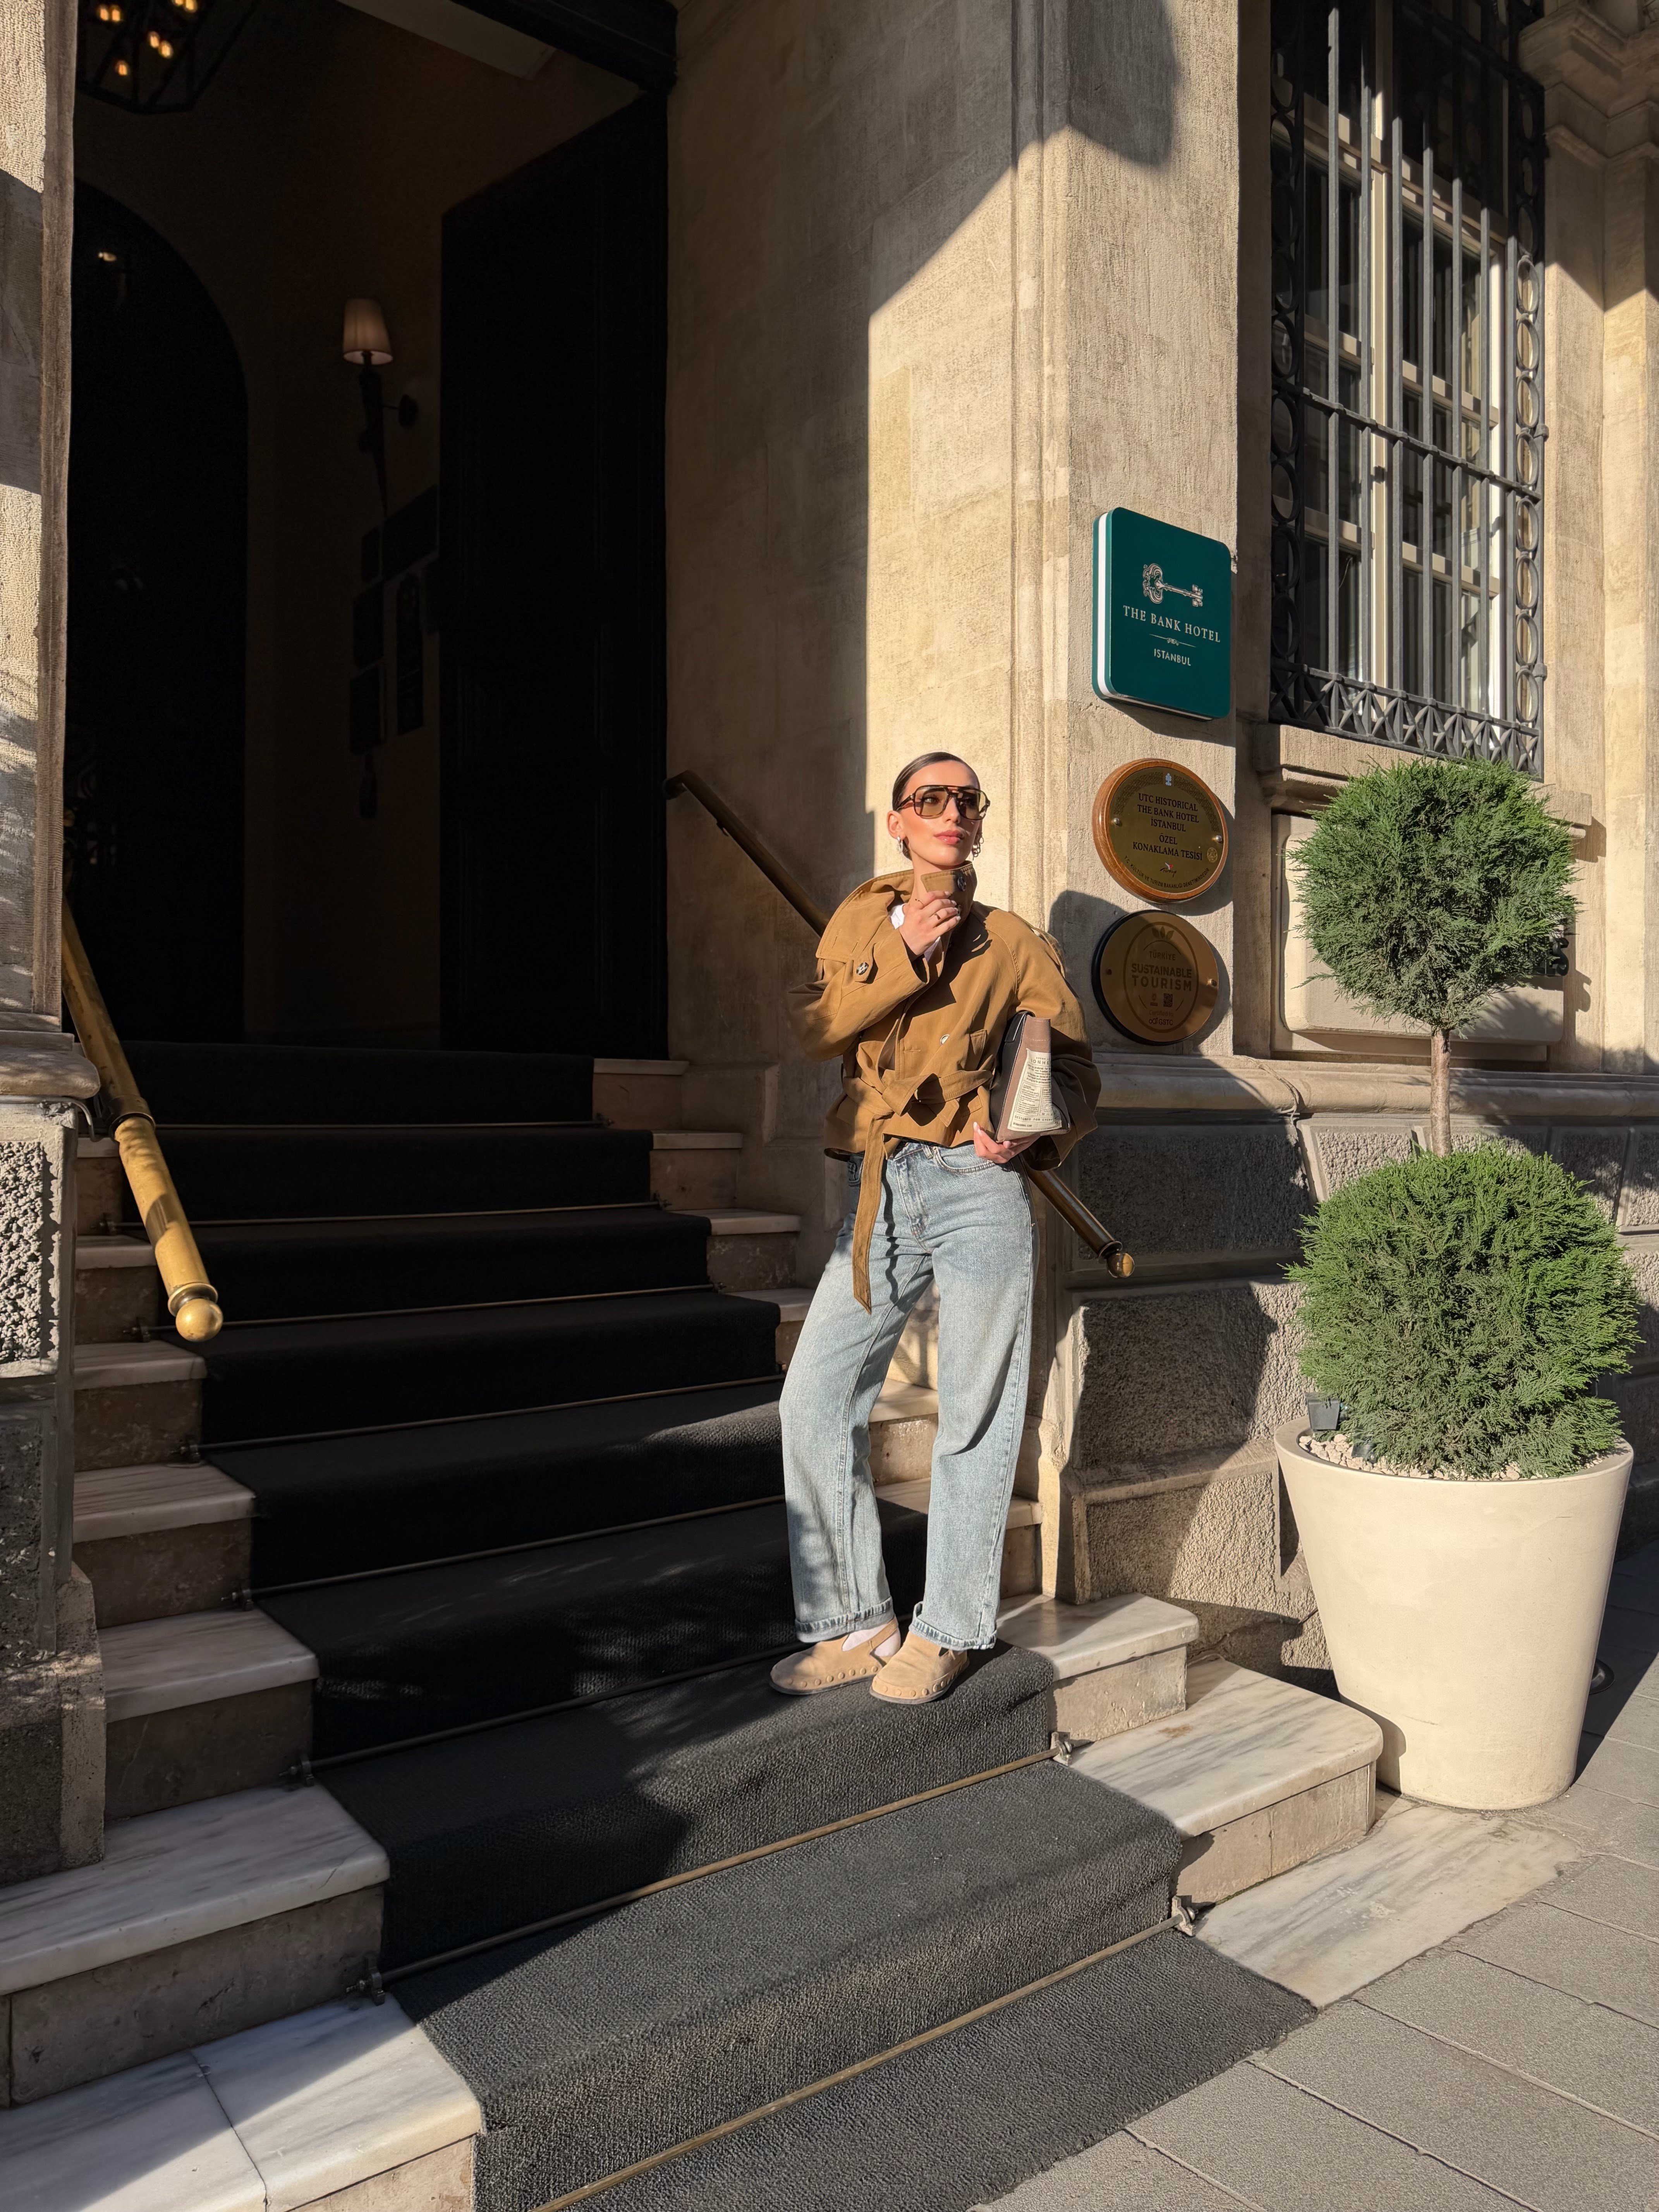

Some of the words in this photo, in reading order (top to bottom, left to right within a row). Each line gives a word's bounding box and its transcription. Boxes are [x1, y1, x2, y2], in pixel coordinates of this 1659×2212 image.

[1123, 605, 1146, 621] THE
[1151, 613, 1181, 632] BANK
[1185, 623, 1221, 642] HOTEL
[1154, 649, 1191, 666] ISTANBUL
[1139, 793, 1153, 802] UTC
[1156, 796, 1198, 811] HISTORICAL
[1137, 804, 1152, 814] THE
[1154, 807, 1174, 818] BANK
[1176, 812, 1199, 823] HOTEL
[1151, 817, 1186, 832] İSTANBUL
[1159, 833, 1178, 845] ÖZEL
[1133, 842, 1179, 857] KONAKLAMA
[1181, 850, 1202, 860] TESİSİ
[1149, 950, 1176, 960] TÜRKİYE
[1132, 963, 1192, 978] SUSTAINABLE
[1132, 975, 1192, 991] TOURISM
